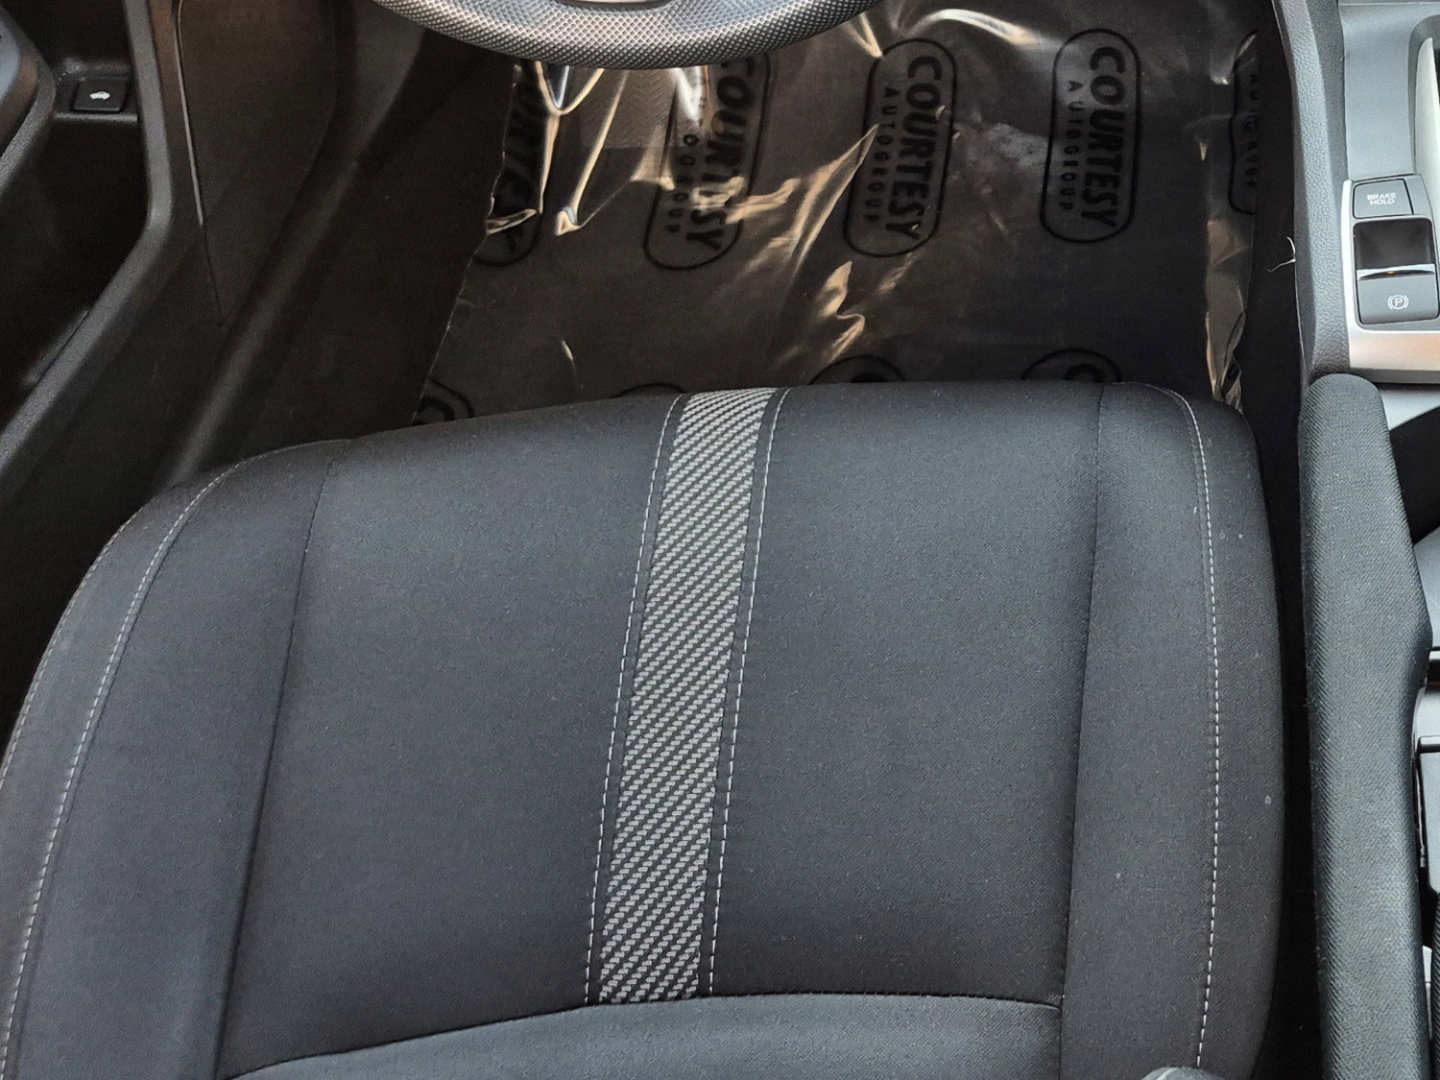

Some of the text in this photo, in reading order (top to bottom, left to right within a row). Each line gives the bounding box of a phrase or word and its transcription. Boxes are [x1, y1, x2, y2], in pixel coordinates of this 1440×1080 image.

[863, 87, 900, 222] AUTOGROUP
[885, 55, 943, 240] COURTESY
[1058, 80, 1085, 210] AUTOGROUP
[1081, 46, 1126, 228] COURTESY
[1367, 192, 1397, 201] BRAKE
